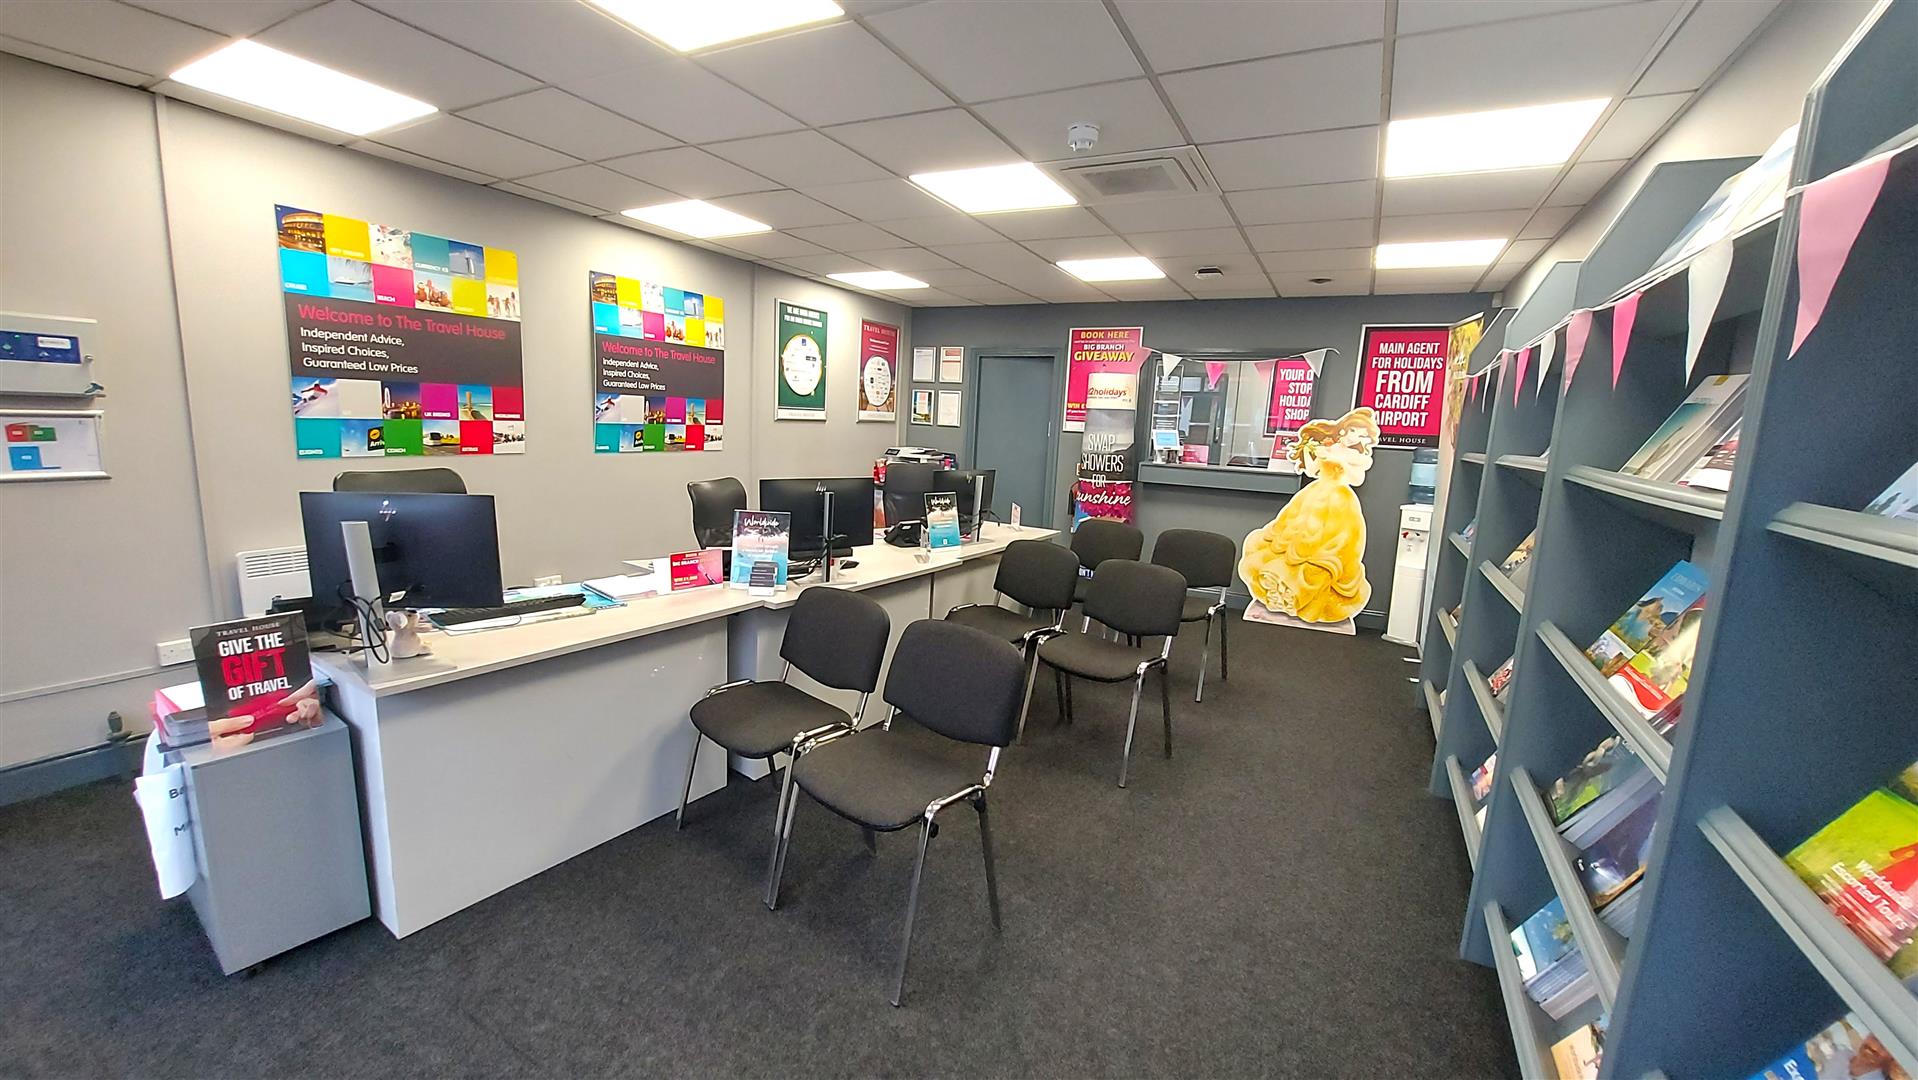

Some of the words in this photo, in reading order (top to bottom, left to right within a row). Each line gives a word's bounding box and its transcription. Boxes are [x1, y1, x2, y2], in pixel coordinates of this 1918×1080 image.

[298, 303, 374, 326] Welcome
[377, 312, 392, 328] to
[395, 315, 422, 332] The
[426, 319, 463, 336] Travel
[467, 323, 506, 340] House
[300, 326, 368, 343] Independent
[370, 333, 405, 347] Advice,
[1080, 331, 1105, 339] BOOK
[1107, 331, 1129, 339] HERE
[302, 342, 345, 357] Inspired
[347, 346, 390, 360] Choices,
[602, 341, 643, 357] Welcome
[645, 348, 653, 357] to
[655, 348, 669, 359] The
[670, 350, 692, 362] Travel
[694, 353, 716, 364] House
[1074, 351, 1135, 362] GIVEAWAY
[1379, 342, 1406, 355] MAIN
[1406, 342, 1441, 355] AGENT
[303, 357, 367, 372] Guaranteed
[369, 361, 389, 373] Low
[391, 363, 419, 374] Prices
[602, 357, 639, 369] Independent
[640, 362, 659, 371] Advice,
[1371, 357, 1392, 369] FOR
[1393, 357, 1444, 370] HOLIDAYS
[602, 368, 626, 379] Inspired
[627, 370, 651, 380] Choices,
[1280, 368, 1304, 381] YOUR
[1375, 370, 1435, 394] FROM
[603, 379, 637, 390] Guaranteed
[638, 381, 649, 390] Low
[650, 382, 666, 391] Prices
[1288, 382, 1313, 394] STOP
[1375, 394, 1430, 410] CARDIFF
[1284, 408, 1310, 421] SHOP
[1374, 411, 1429, 427] AIRPORT
[1088, 433, 1116, 452] SWAP
[1081, 452, 1124, 472] SHOWERS
[1091, 474, 1106, 488] FOR
[216, 627, 249, 638] TRAVEL
[251, 621, 281, 632] HOUSE
[217, 637, 254, 657] GIVE
[255, 632, 285, 650] THE
[222, 650, 286, 686] GIFT
[228, 686, 245, 701] OF
[247, 675, 292, 697] TRAVEL
[1855, 859, 1914, 909] Worldwide
[1830, 861, 1882, 904] Escorted
[1874, 899, 1909, 930] Tours
